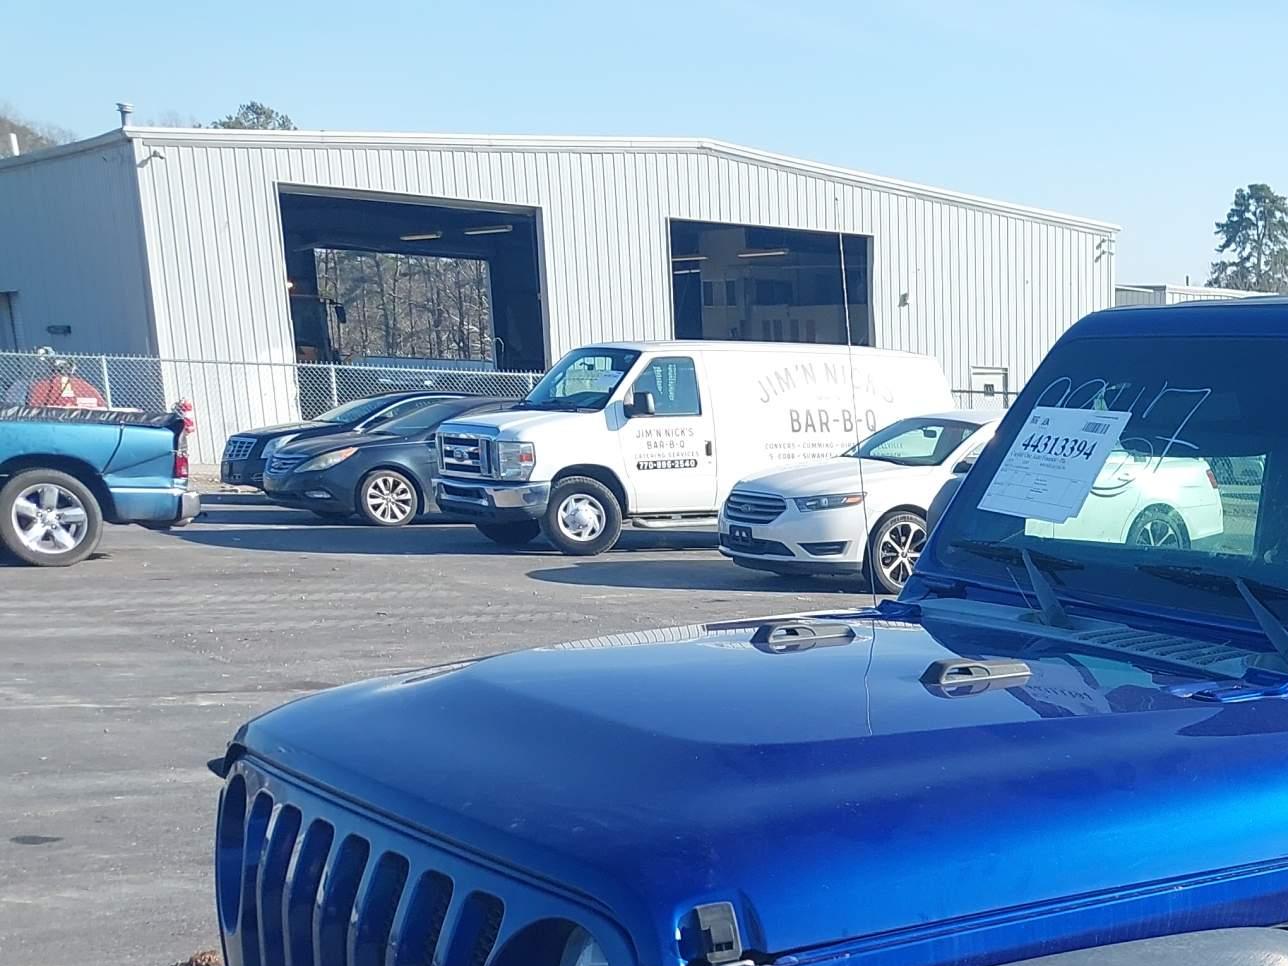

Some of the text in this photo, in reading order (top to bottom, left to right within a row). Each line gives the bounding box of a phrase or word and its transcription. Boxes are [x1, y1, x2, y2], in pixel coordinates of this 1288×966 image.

[789, 408, 877, 433] BAR-B-Q
[646, 440, 685, 449] BAR-B-Q
[1022, 432, 1098, 461] 44313394
